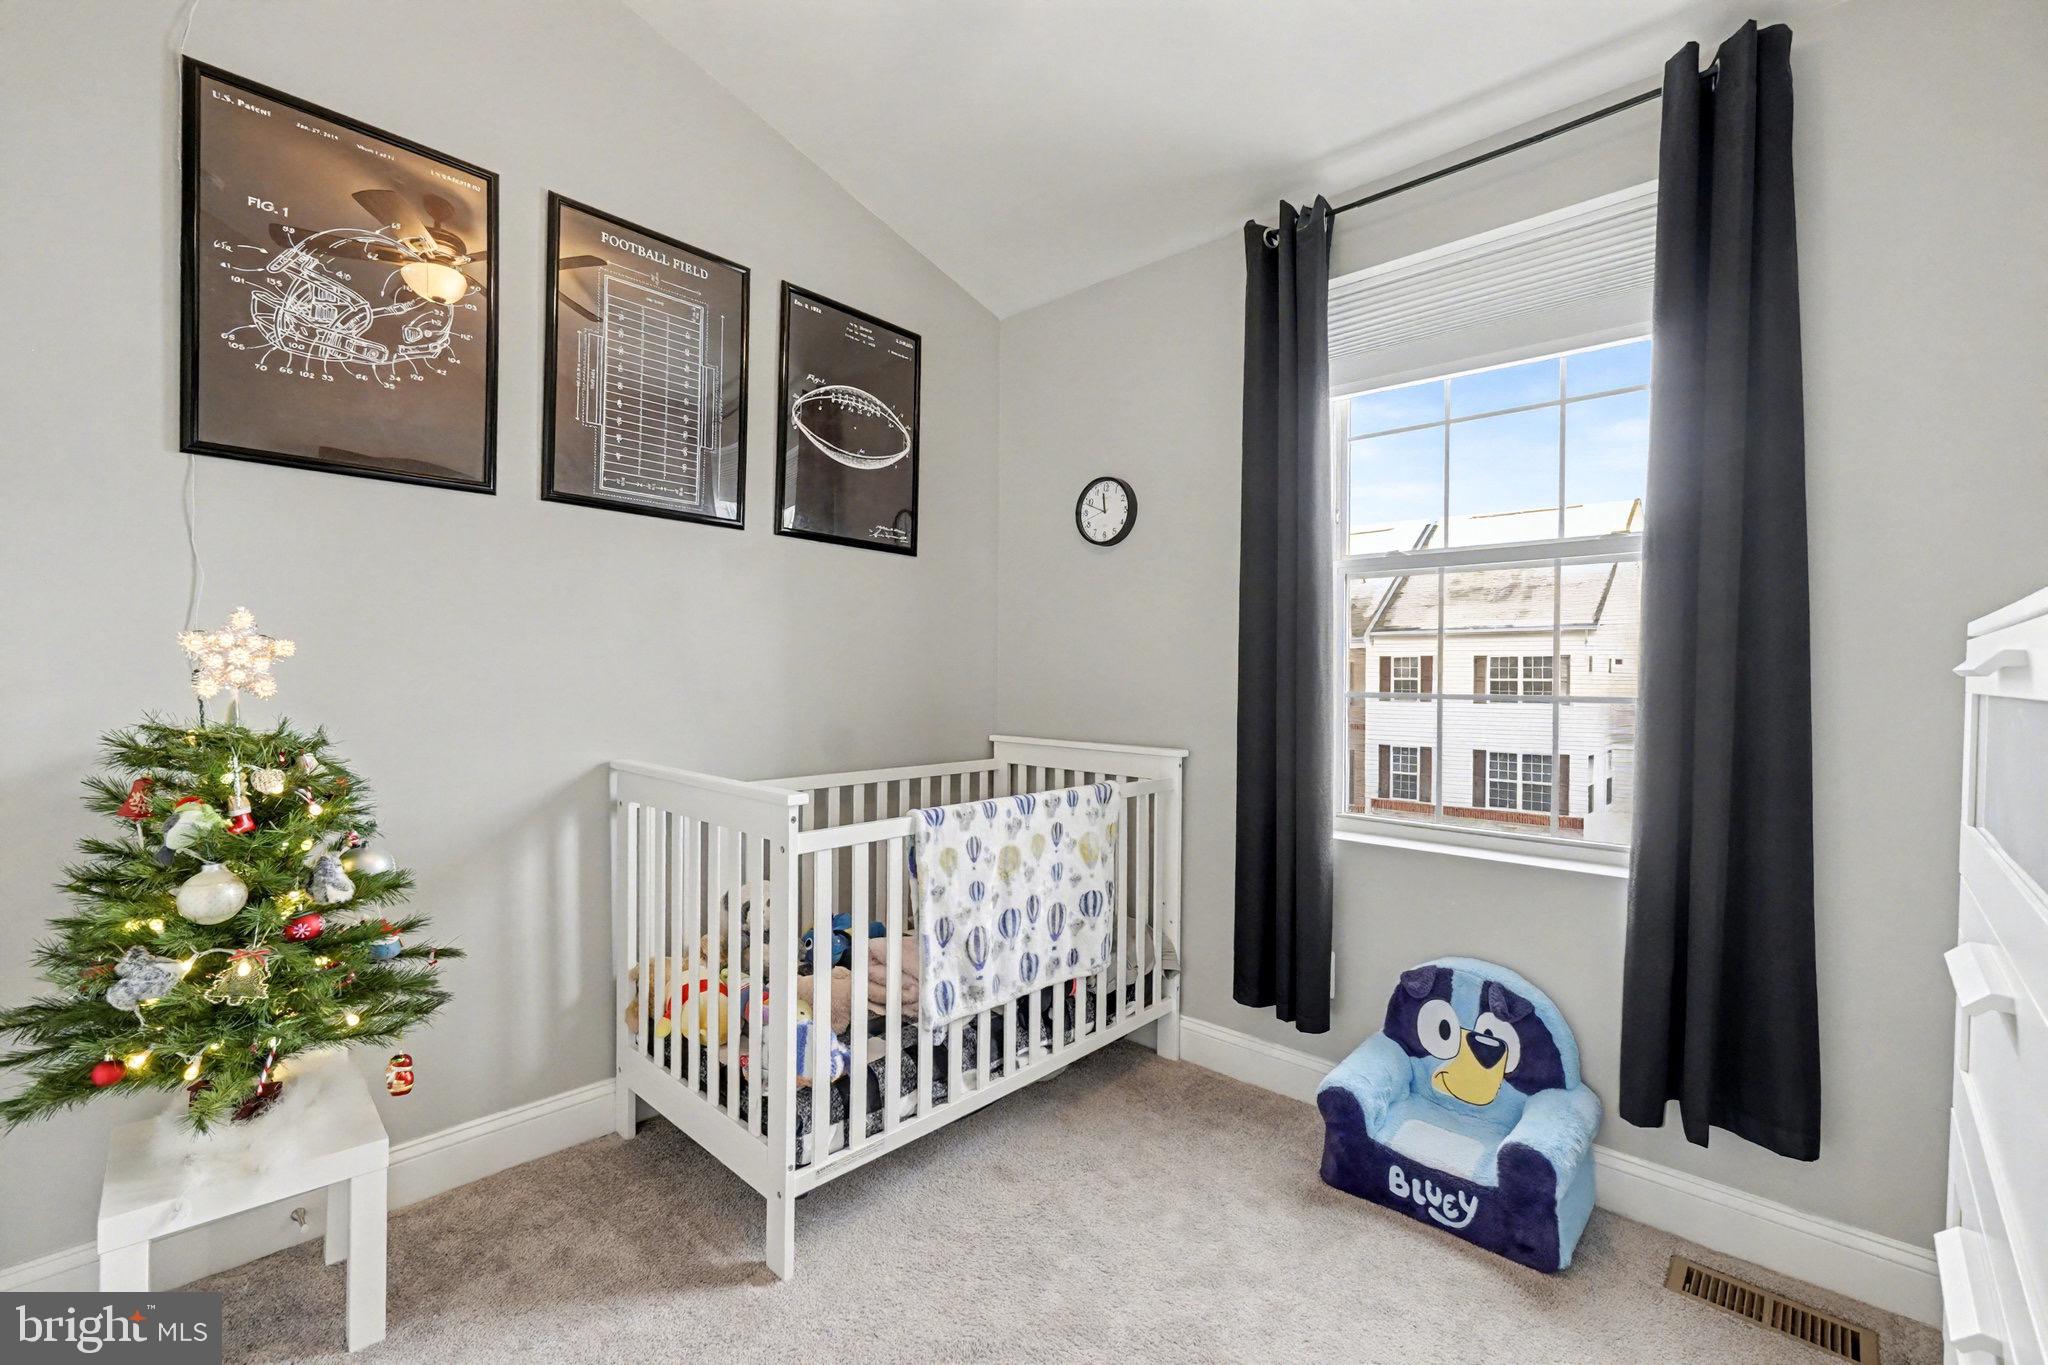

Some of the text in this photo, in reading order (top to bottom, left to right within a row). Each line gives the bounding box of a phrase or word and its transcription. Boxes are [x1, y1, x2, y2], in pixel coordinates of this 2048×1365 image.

[212, 90, 235, 105] U.S.
[247, 195, 289, 218] FIG. 1
[601, 231, 671, 267] FOOTBALL
[672, 257, 709, 280] FIELD
